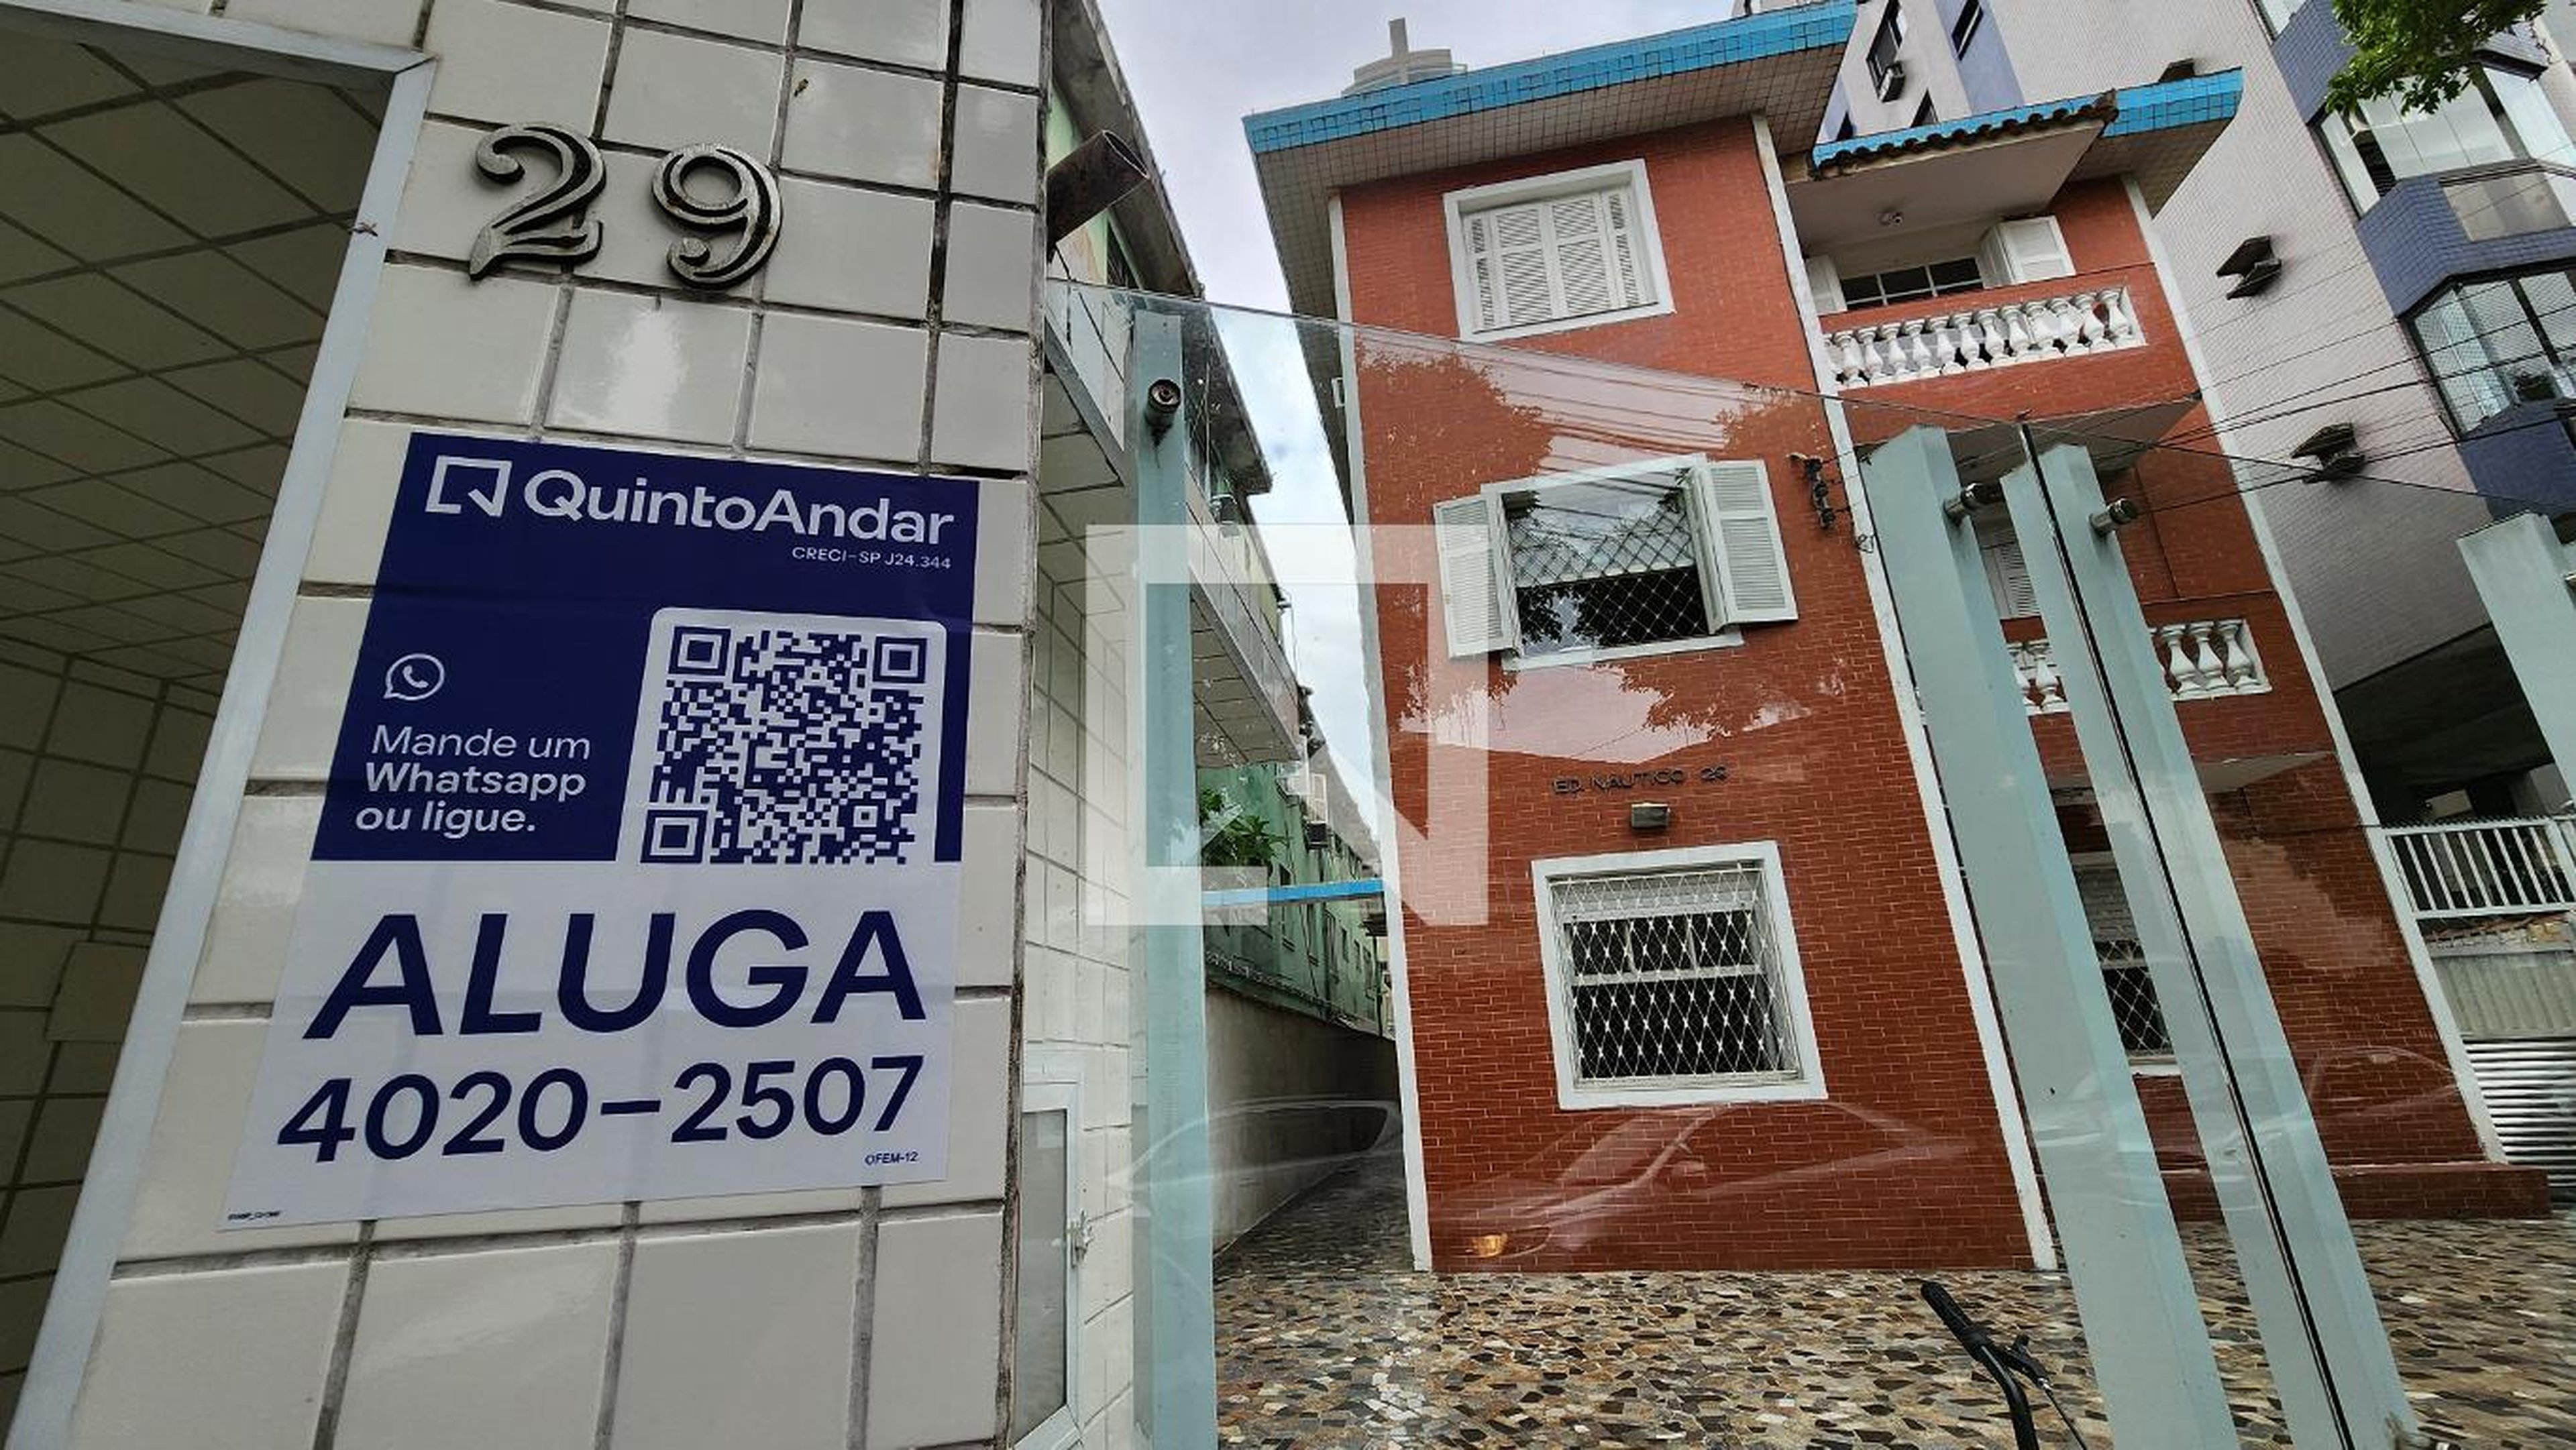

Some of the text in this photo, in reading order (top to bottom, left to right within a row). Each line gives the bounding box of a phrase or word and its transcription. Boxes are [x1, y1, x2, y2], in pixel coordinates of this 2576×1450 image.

[470, 123, 783, 290] 29
[523, 469, 955, 545] QuintoAndar
[792, 547, 951, 569] CRECI-SP J24.344
[371, 724, 590, 761] Mande um
[365, 762, 586, 803] Whatsapp
[355, 800, 536, 840] ou ligue.
[302, 909, 927, 1040] ALUGA
[277, 1055, 924, 1164] 4020-2507
